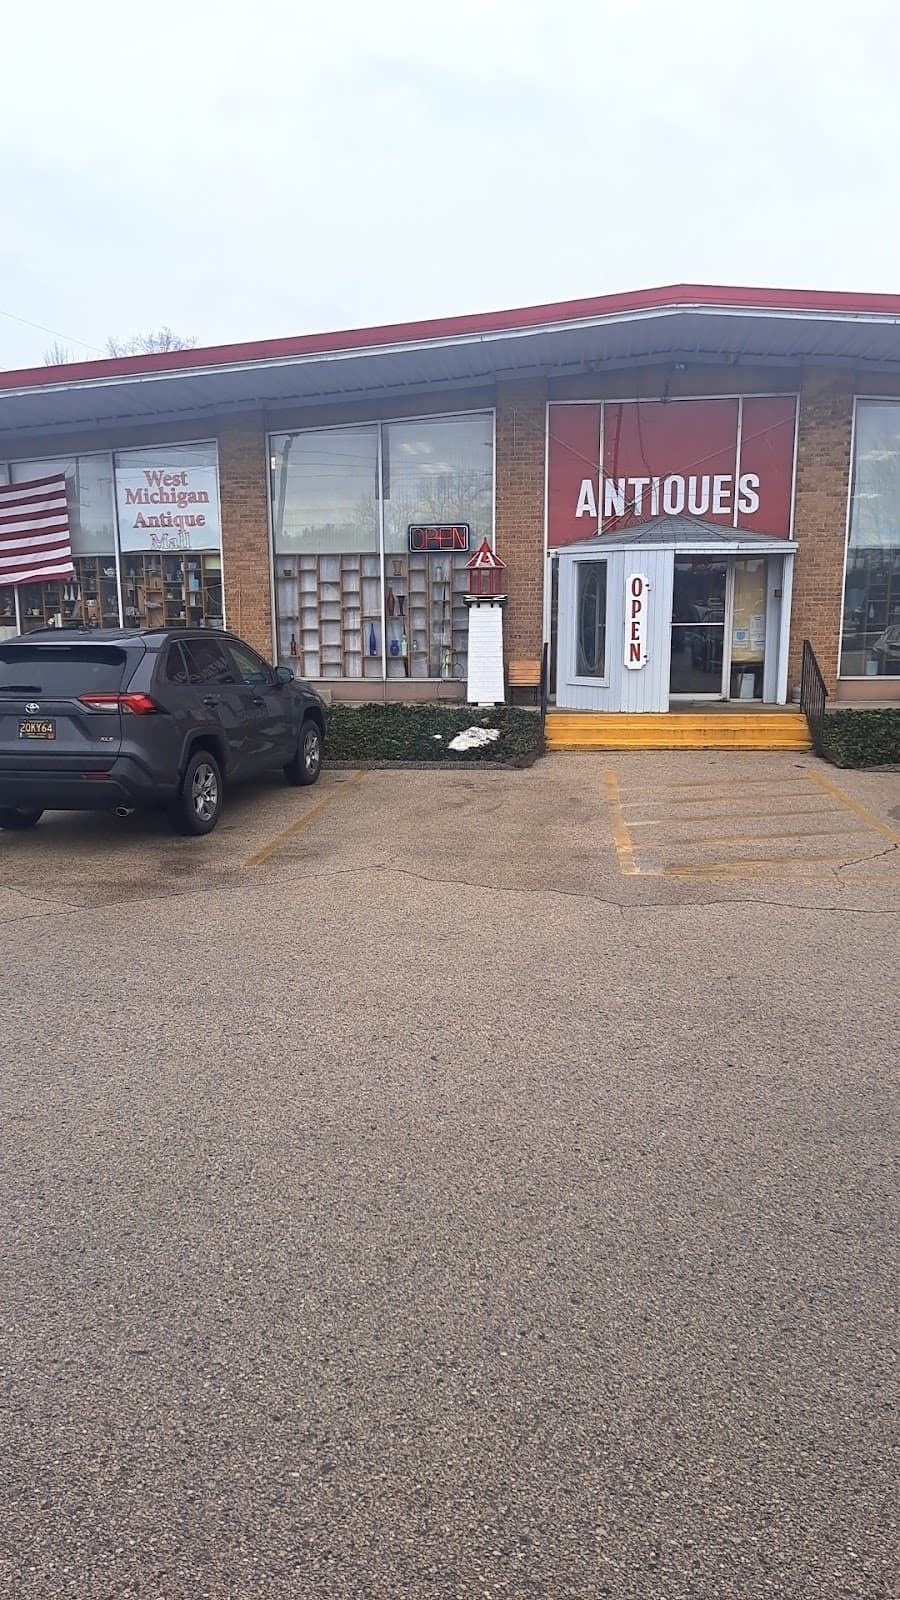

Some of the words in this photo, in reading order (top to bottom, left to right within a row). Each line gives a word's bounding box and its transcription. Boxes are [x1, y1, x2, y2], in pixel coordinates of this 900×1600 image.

[143, 470, 188, 487] West
[124, 487, 210, 508] Michigan
[575, 473, 760, 518] ANTIQUES
[133, 511, 206, 530] Antique
[149, 530, 191, 550] Mall
[411, 527, 466, 549] OPEN
[629, 577, 643, 662] OPEN
